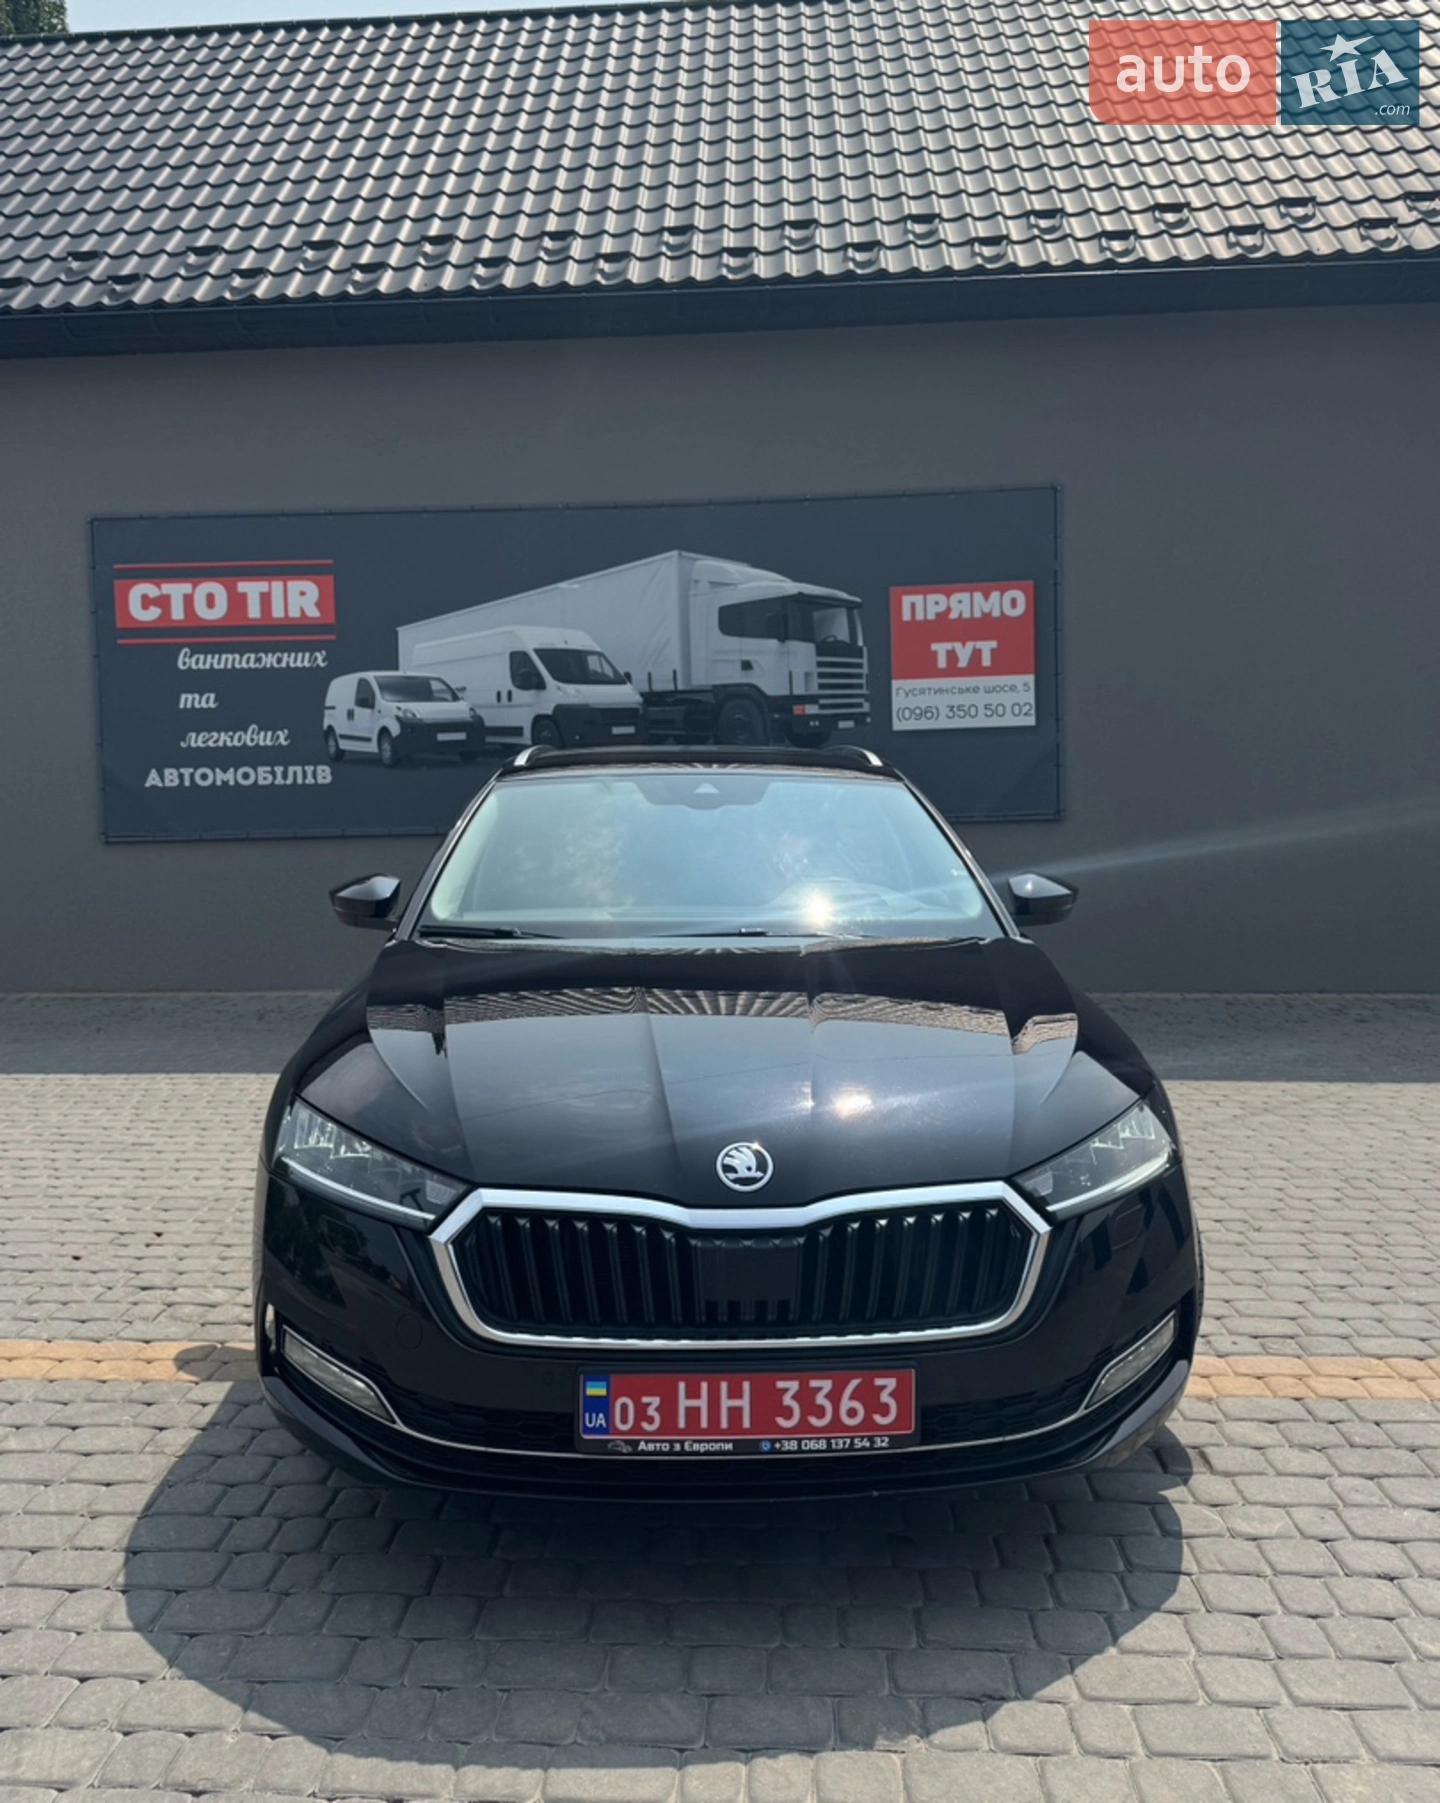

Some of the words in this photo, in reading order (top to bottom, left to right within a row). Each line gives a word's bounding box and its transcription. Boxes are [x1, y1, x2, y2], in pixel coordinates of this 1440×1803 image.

[128, 582, 228, 622] СТО
[237, 580, 321, 619] TIR
[901, 589, 1026, 621] ПРЯМО
[177, 648, 328, 670] вантажних
[930, 640, 998, 669] ТУТ
[179, 693, 218, 709] та
[895, 685, 980, 699] Гусятинське
[1022, 682, 1031, 693] 5
[896, 705, 940, 722] (096)
[945, 704, 979, 719] 350
[983, 703, 1006, 718] 50
[1010, 702, 1033, 717] 02
[180, 724, 290, 748] легкових
[144, 765, 332, 787] АВТОМОБІЛІВ
[614, 1396, 661, 1432] 03
[677, 1380, 750, 1429] HH
[774, 1377, 897, 1428] 3363
[585, 1413, 607, 1429] UA
[638, 1440, 670, 1452] Авто
[673, 1442, 681, 1452] з
[684, 1440, 733, 1454] Європи
[774, 1440, 798, 1452] +38
[801, 1439, 827, 1451] 068
[830, 1438, 851, 1450] 137
[853, 1437, 871, 1449] 54
[873, 1436, 890, 1448] 32
